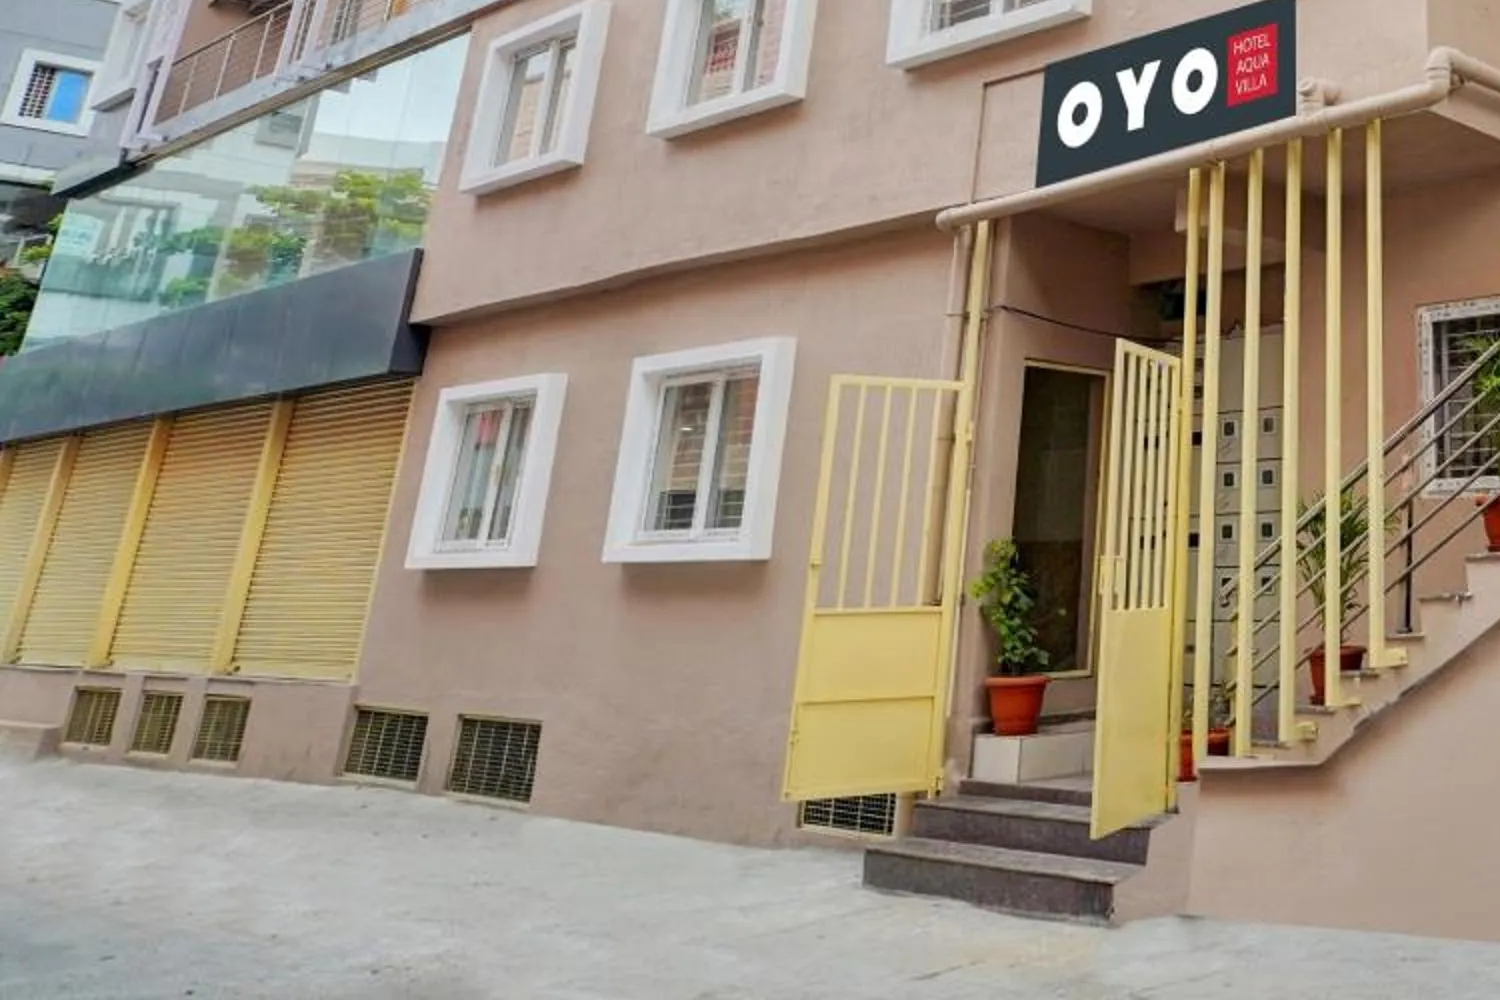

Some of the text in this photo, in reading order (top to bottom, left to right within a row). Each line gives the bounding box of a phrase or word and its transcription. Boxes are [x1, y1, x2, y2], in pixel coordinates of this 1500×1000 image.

[1233, 33, 1270, 54] HOTEL
[1236, 54, 1270, 75] AQUA
[1235, 73, 1267, 95] VILLA
[1057, 47, 1219, 148] OYO
